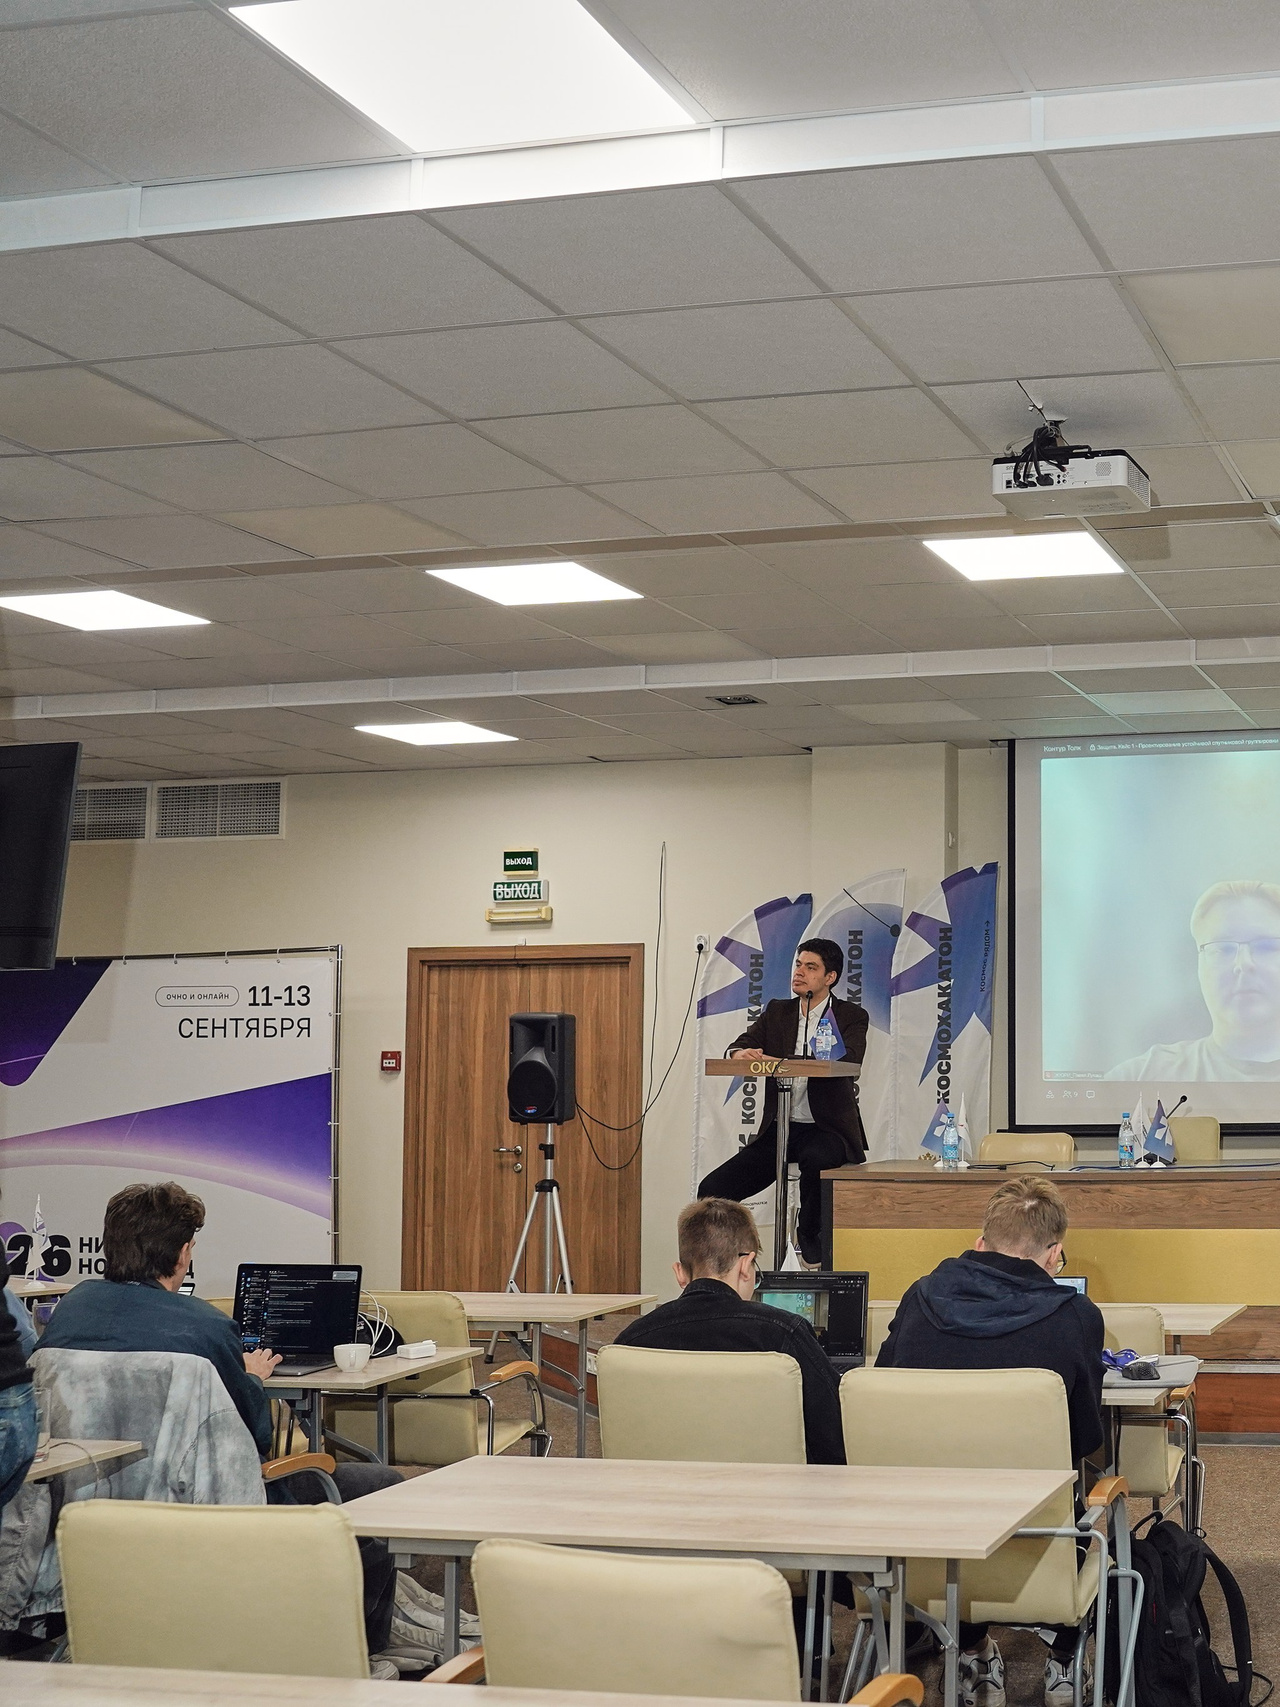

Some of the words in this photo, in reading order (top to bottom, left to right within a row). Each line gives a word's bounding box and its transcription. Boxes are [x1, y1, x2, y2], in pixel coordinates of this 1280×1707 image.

[506, 857, 532, 866] ВЫХОД
[496, 882, 540, 899] ВЫХОД
[980, 959, 988, 992] КОСМОС
[197, 992, 230, 1000] ОНЛАЙН
[248, 985, 311, 1007] 11-13
[936, 927, 953, 1105] КОСМОХАКАТОН
[178, 1017, 311, 1039] СЕНТЯБРЯ
